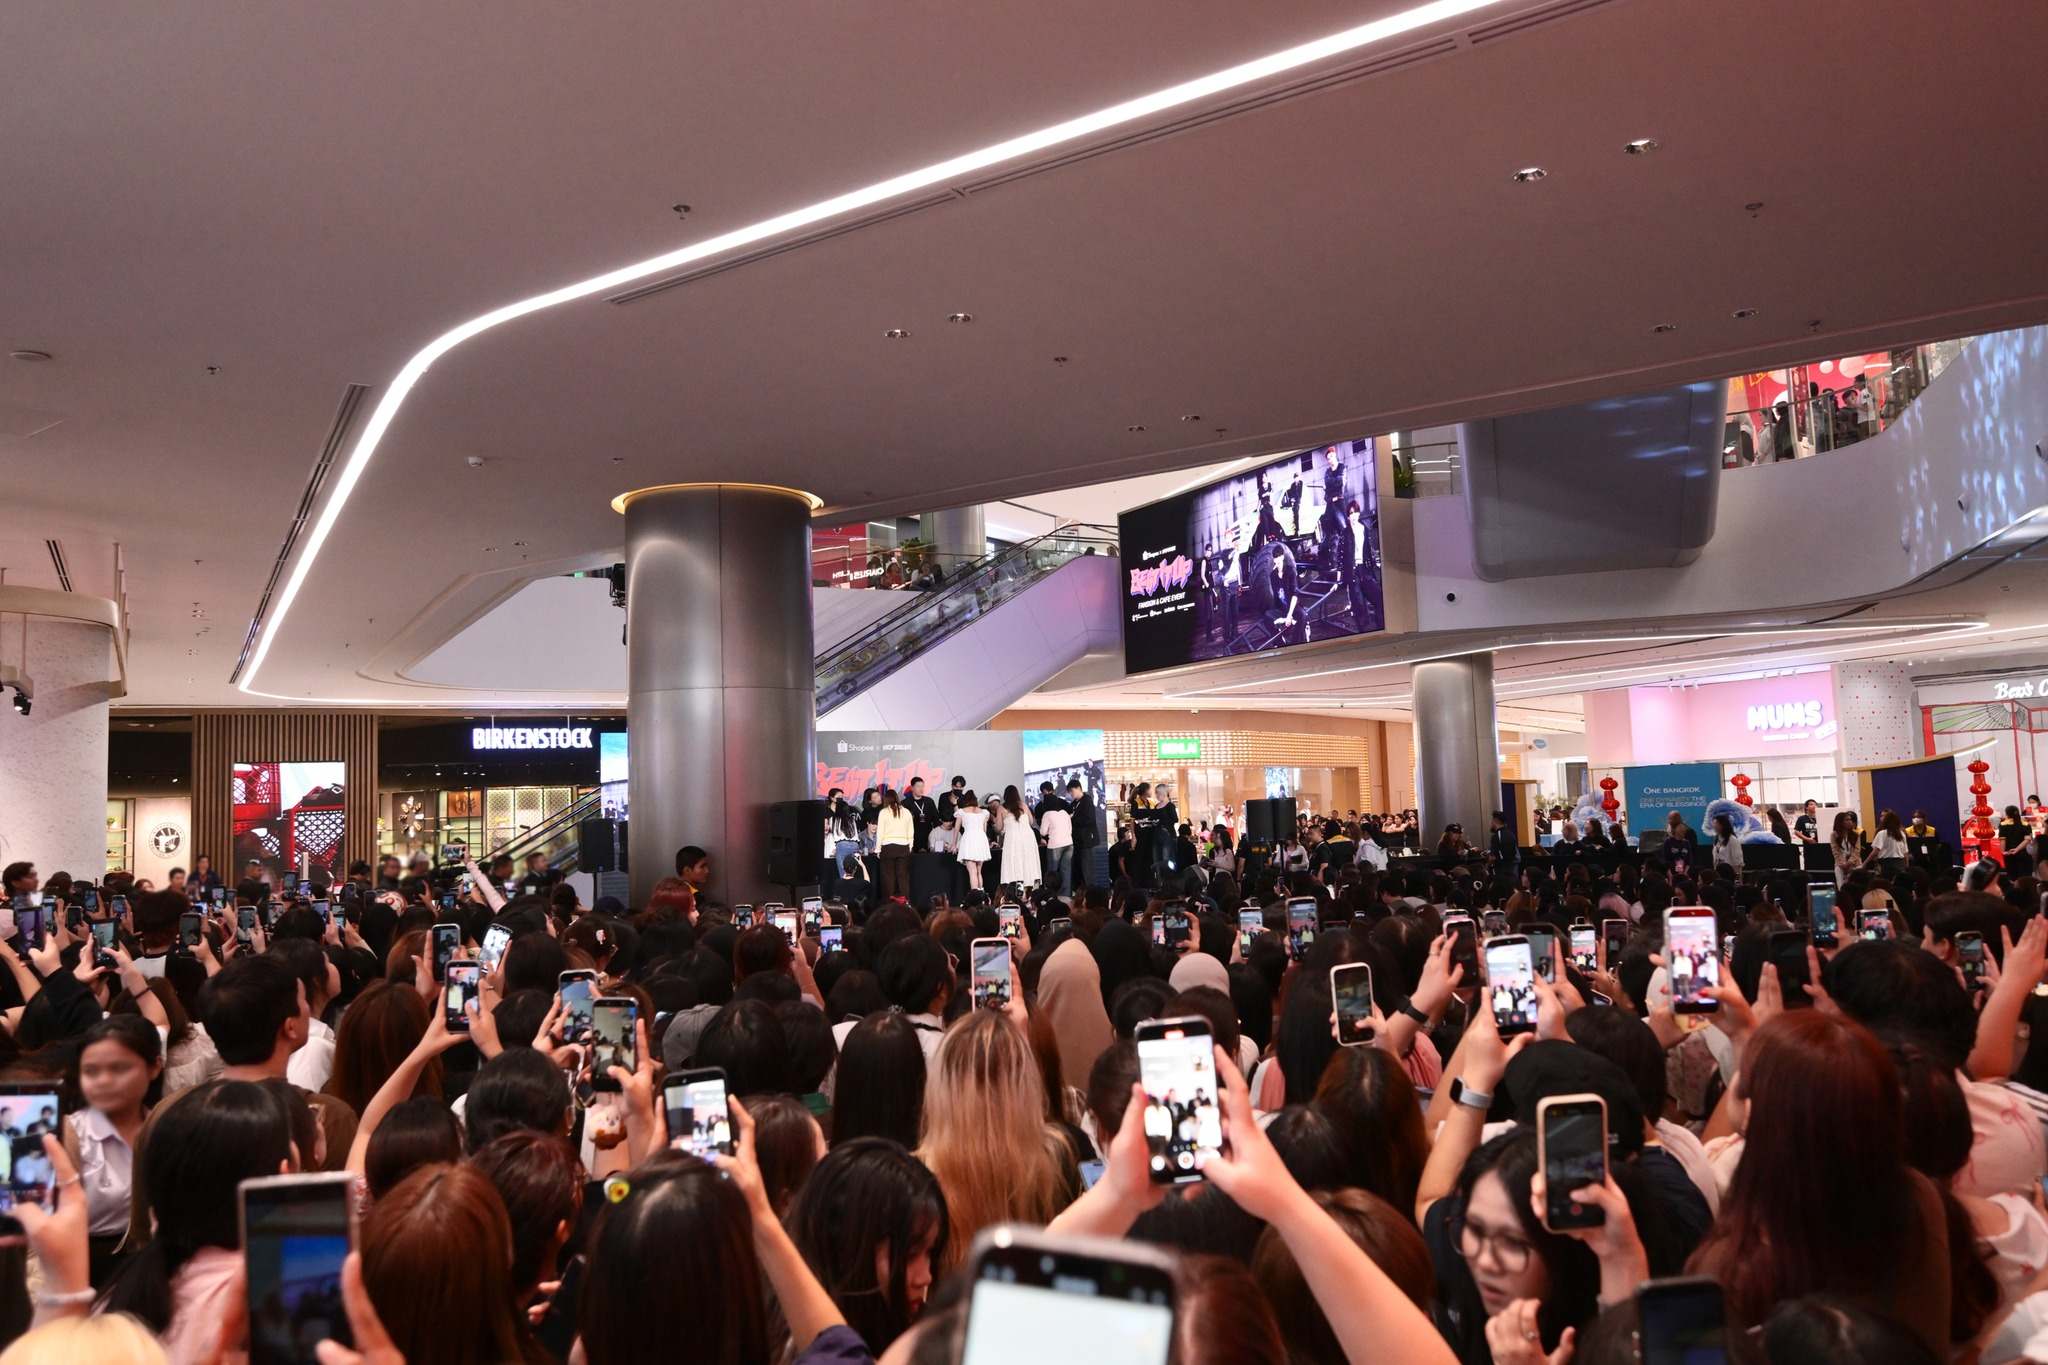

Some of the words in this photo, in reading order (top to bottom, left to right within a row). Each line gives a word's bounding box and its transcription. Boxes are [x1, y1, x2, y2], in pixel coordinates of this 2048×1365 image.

[1747, 700, 1823, 731] MUMS
[473, 727, 593, 750] BIRKENSTOCK
[848, 744, 874, 752] Shopee
[1643, 786, 1661, 794] ONE
